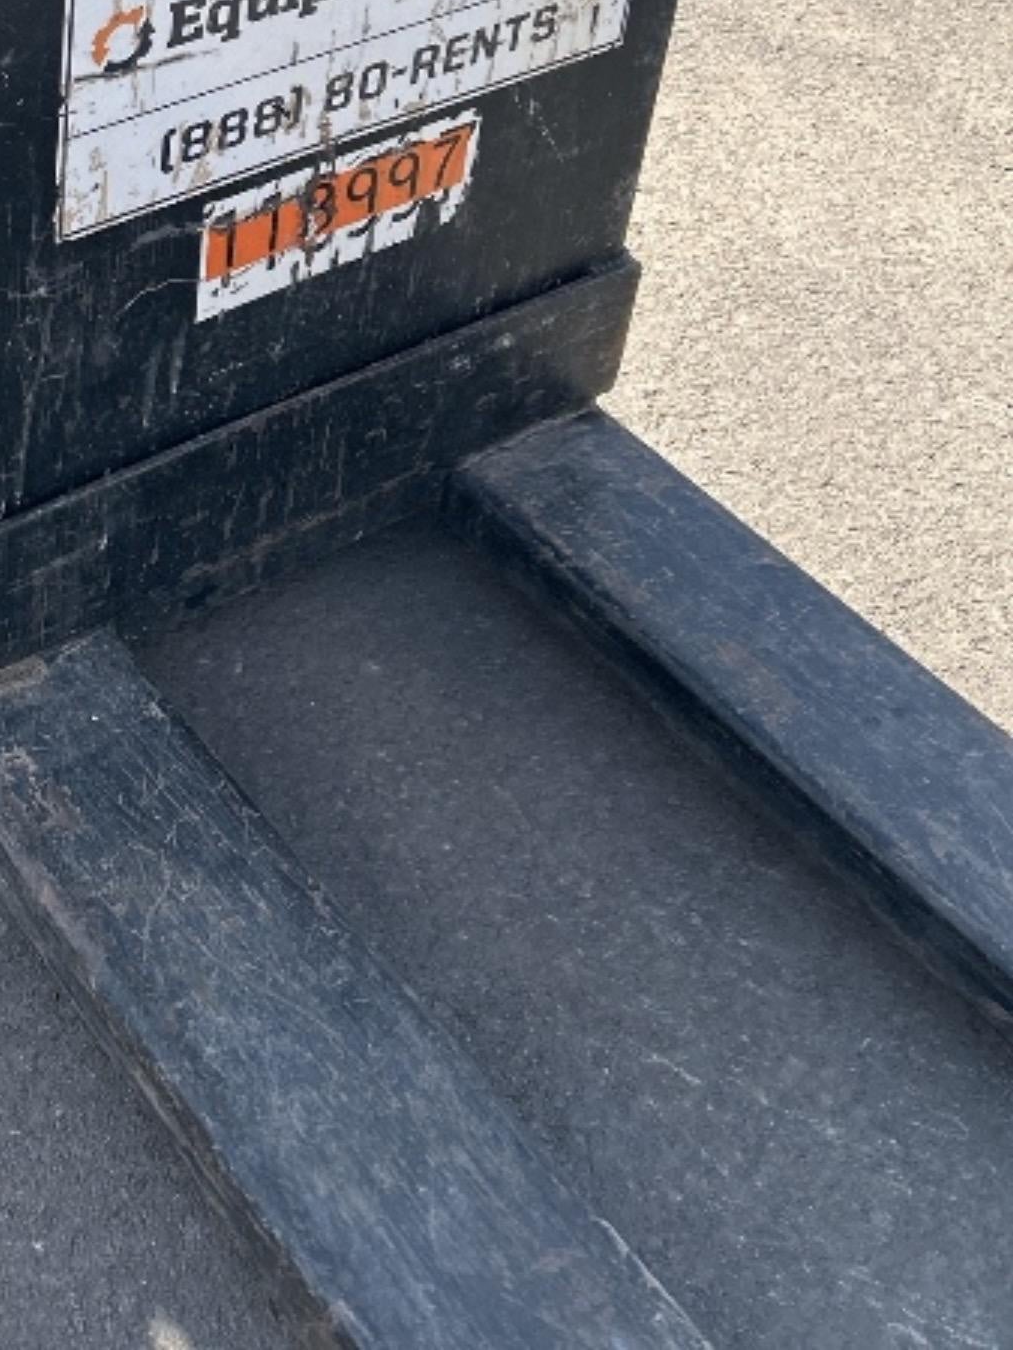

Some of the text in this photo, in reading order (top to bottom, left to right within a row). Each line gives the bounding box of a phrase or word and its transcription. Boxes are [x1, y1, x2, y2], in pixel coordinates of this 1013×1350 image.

[161, 5, 560, 173] (888) 80-RENTS
[205, 120, 477, 287] 118997
